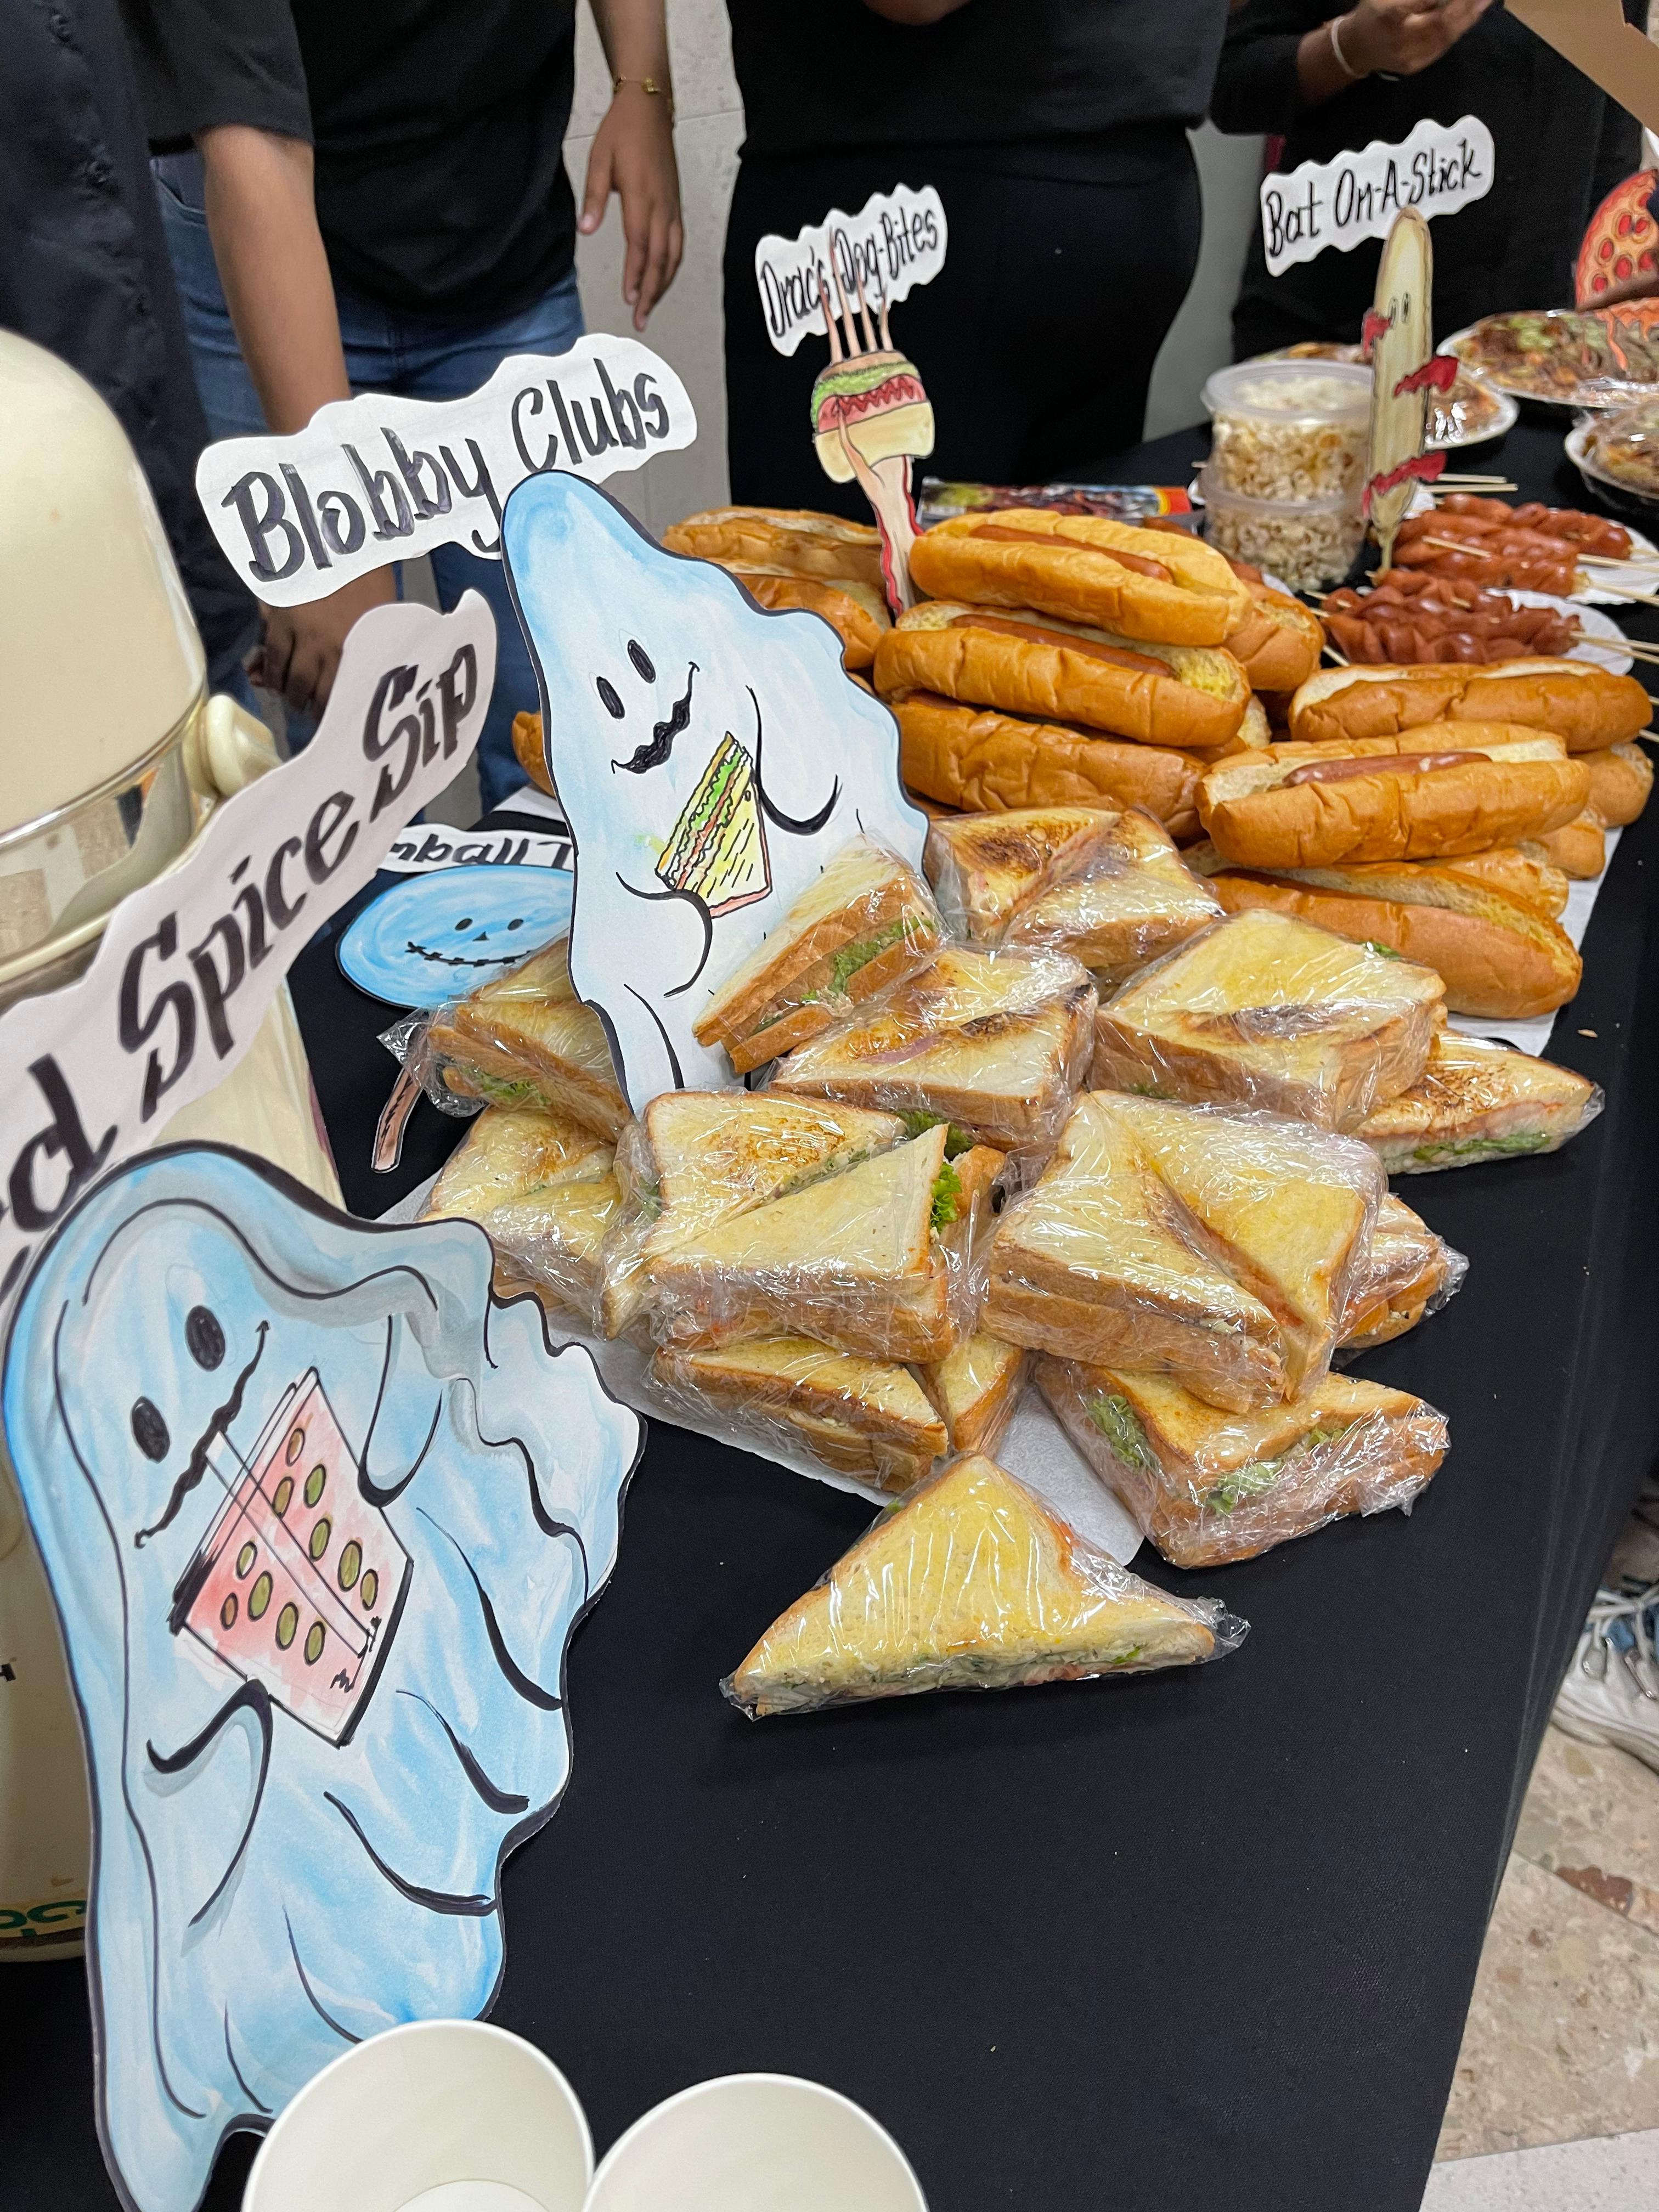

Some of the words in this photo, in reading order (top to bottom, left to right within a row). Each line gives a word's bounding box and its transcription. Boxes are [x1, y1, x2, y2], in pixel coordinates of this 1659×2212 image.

[1266, 180, 1323, 257] Bat
[1334, 137, 1481, 228] On-A-Stick
[760, 245, 830, 337] Drac's
[221, 427, 503, 582] Blobby
[511, 358, 669, 473] Clubs
[118, 791, 360, 1124] Spice
[363, 642, 478, 823] Sip
